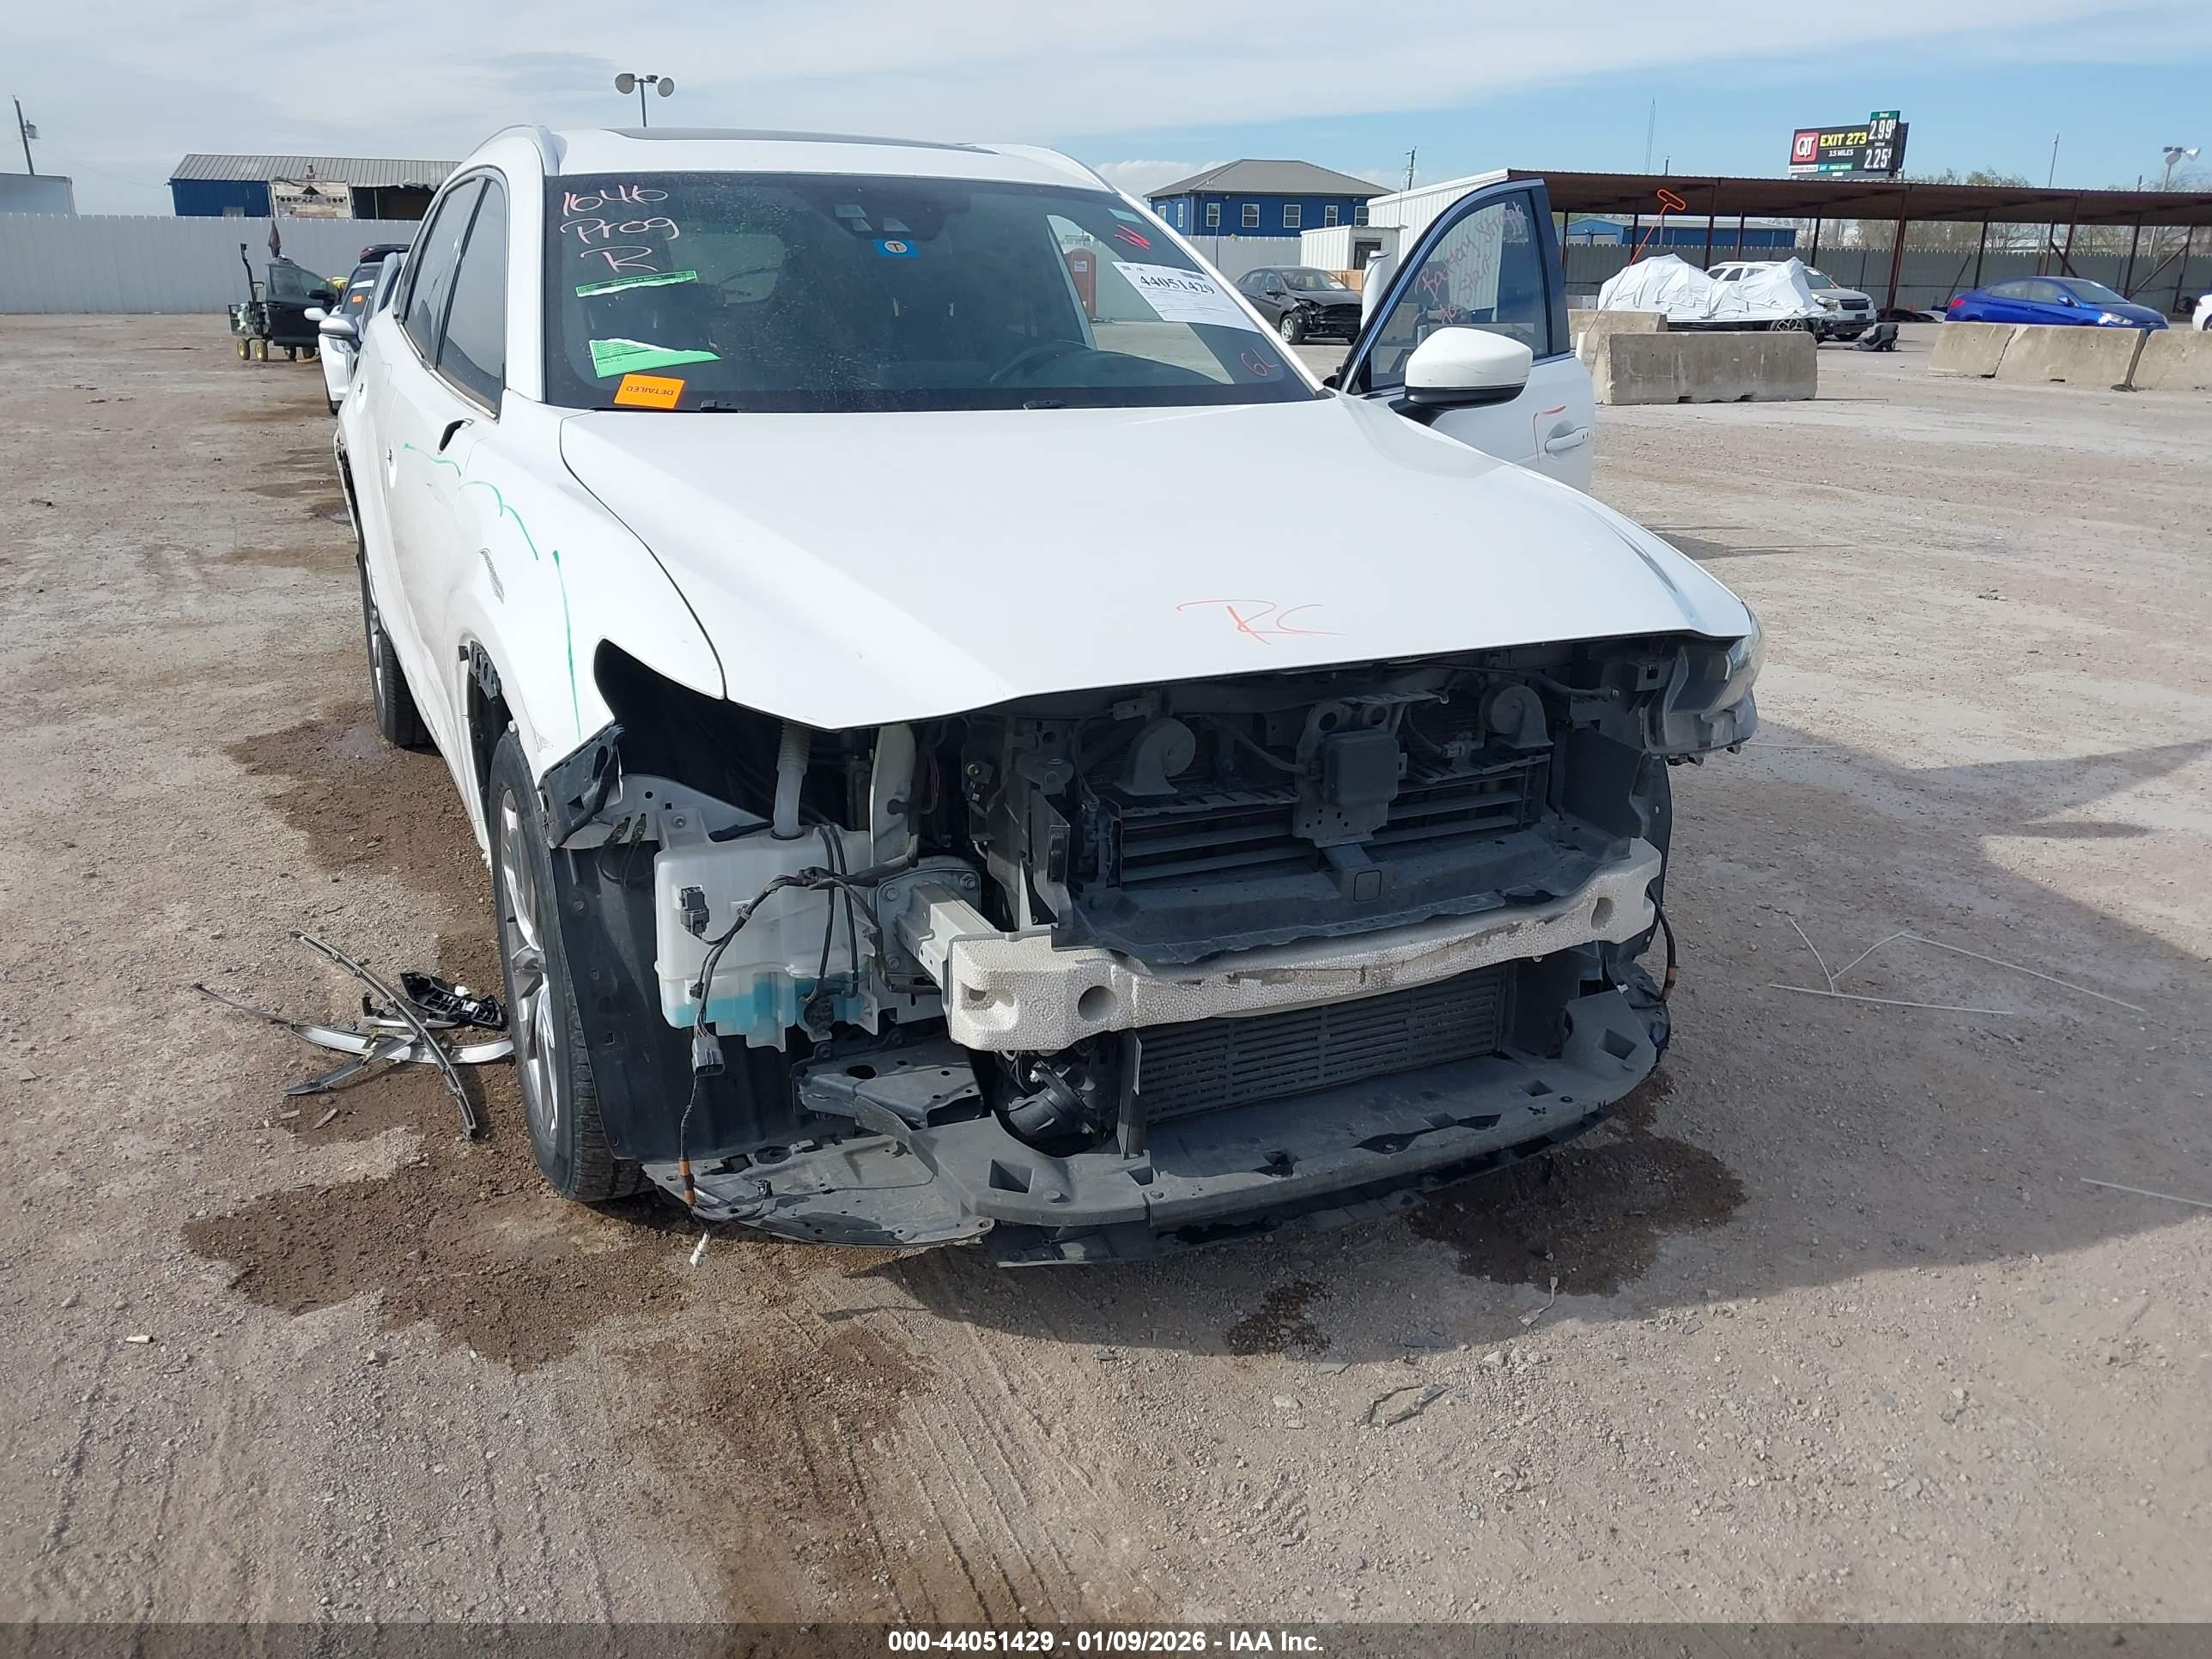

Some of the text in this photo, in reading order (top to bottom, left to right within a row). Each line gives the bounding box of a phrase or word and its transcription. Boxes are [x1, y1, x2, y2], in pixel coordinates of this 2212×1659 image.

[1820, 131, 1868, 148] EXIT 273
[1837, 148, 1854, 157] MILES
[559, 216, 680, 245] Prog
[580, 246, 659, 274] R
[1139, 275, 1216, 295] 44051429
[625, 386, 675, 397] DETAILED
